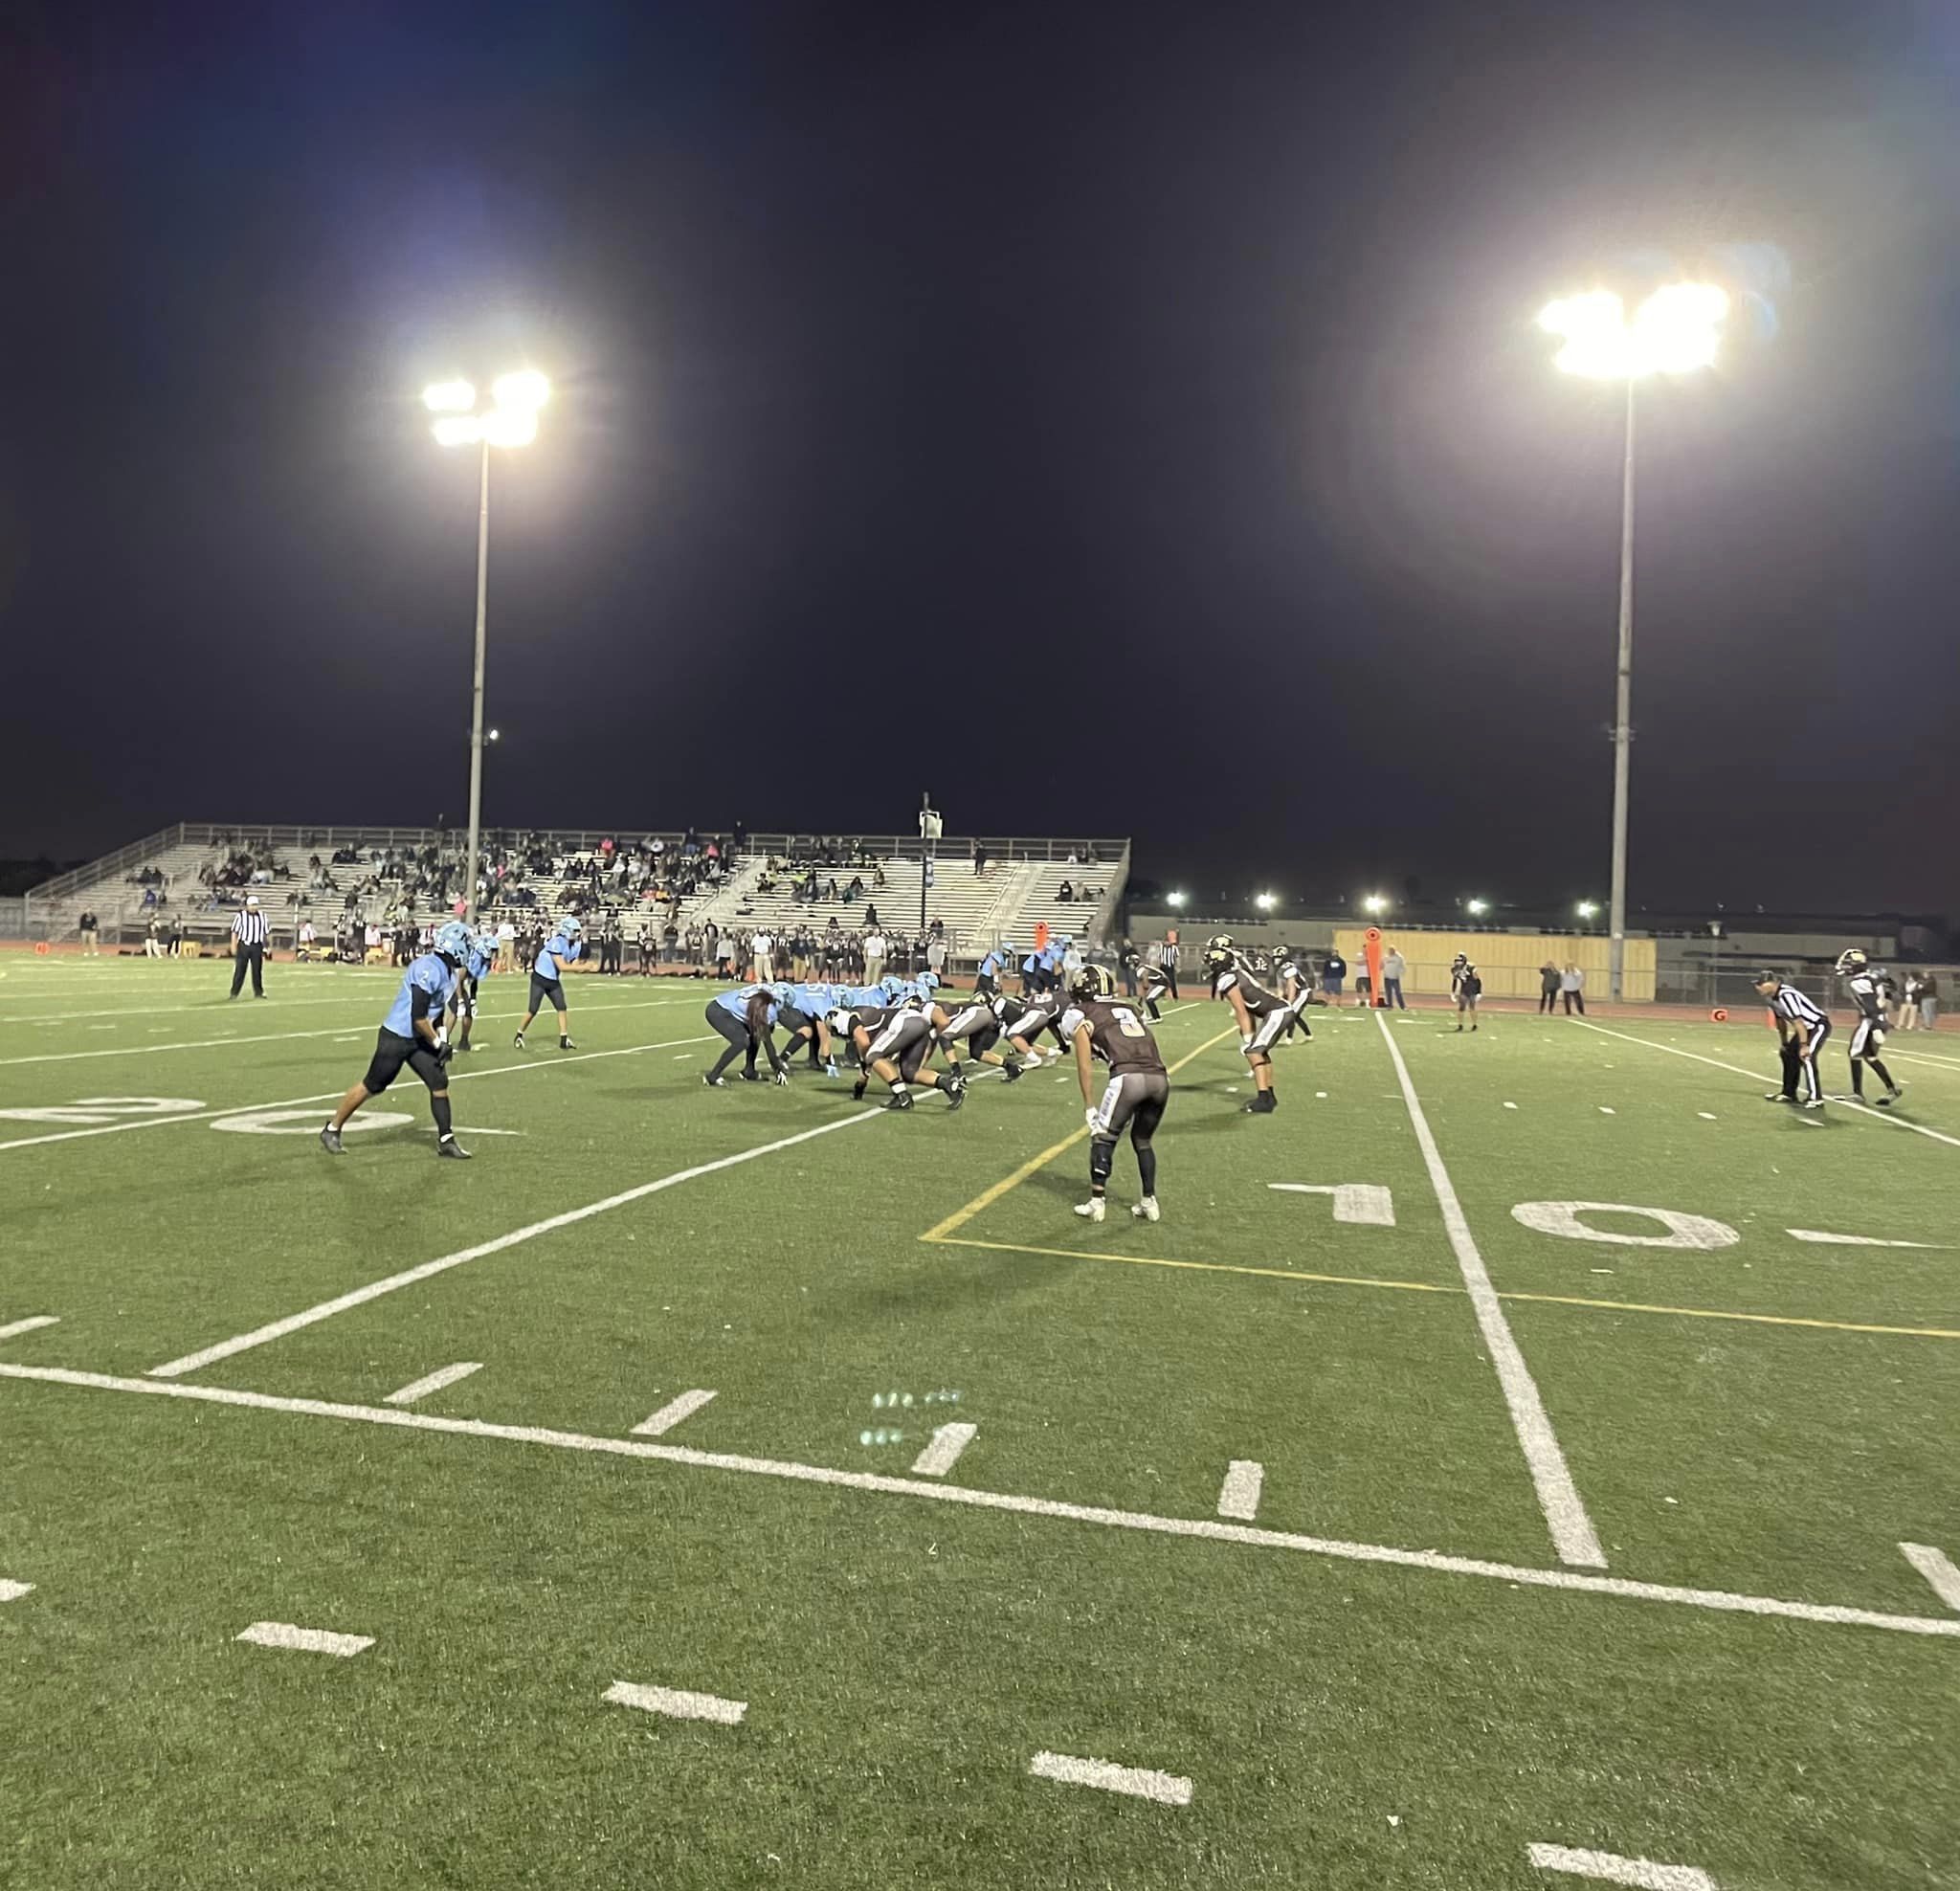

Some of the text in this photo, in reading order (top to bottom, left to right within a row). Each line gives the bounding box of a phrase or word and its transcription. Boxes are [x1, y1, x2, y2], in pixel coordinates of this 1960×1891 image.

[420, 970, 429, 986] 2
[1111, 1008, 1146, 1037] 3
[1714, 1010, 1726, 1022] G
